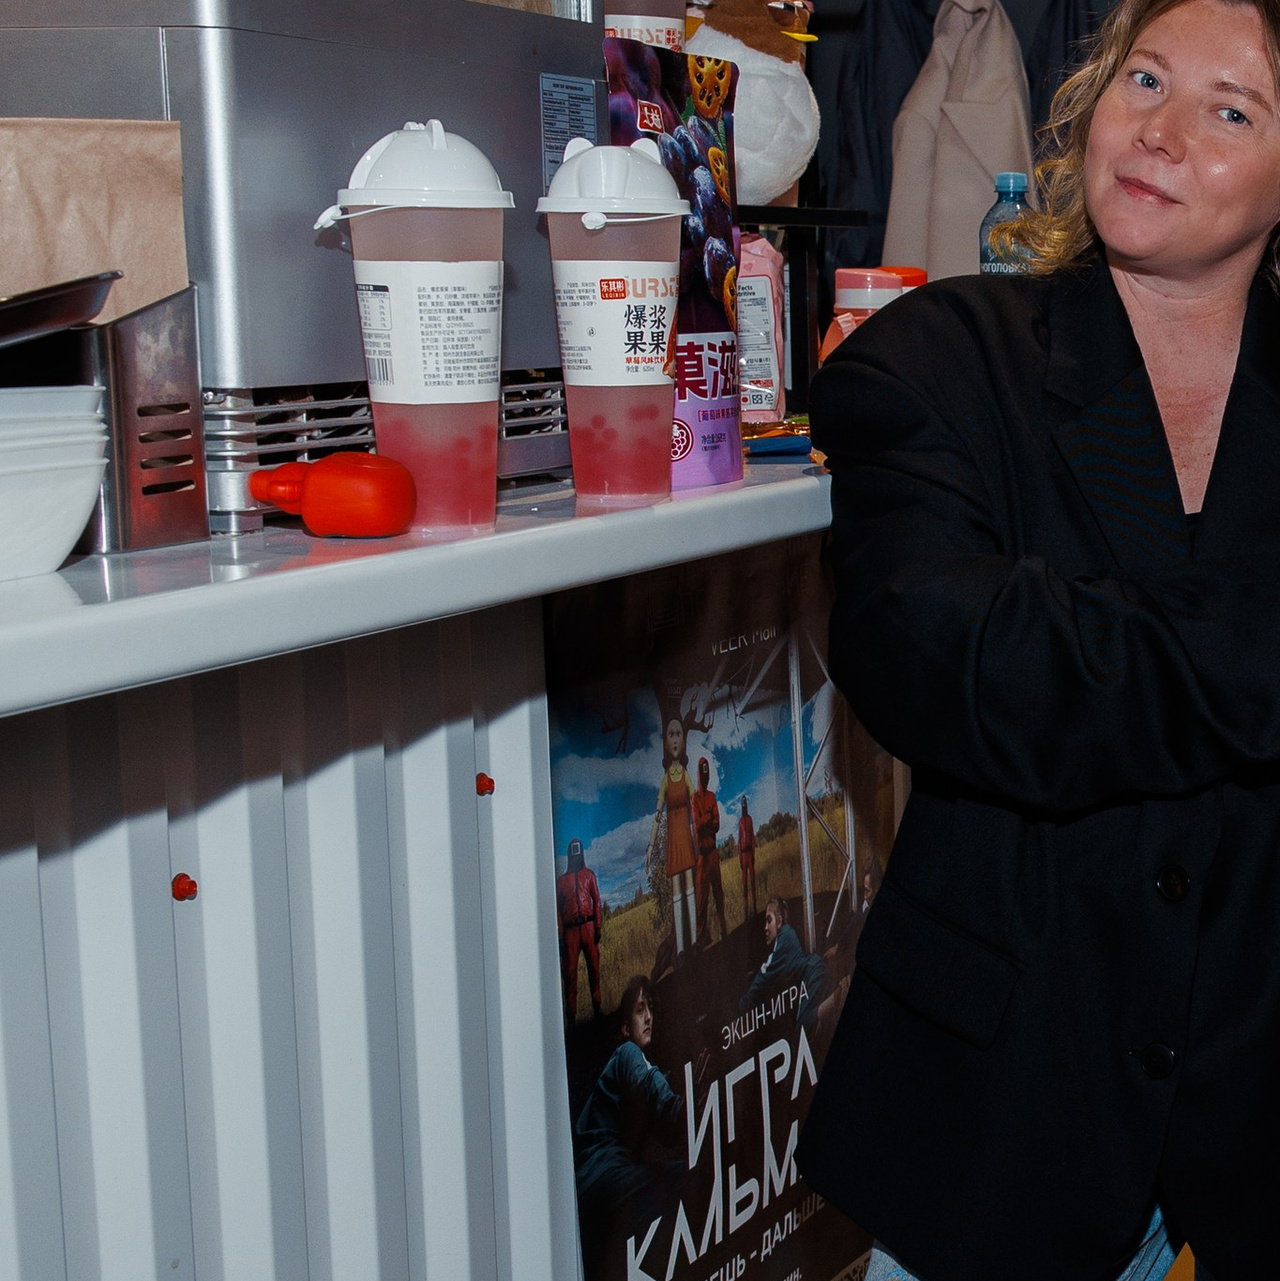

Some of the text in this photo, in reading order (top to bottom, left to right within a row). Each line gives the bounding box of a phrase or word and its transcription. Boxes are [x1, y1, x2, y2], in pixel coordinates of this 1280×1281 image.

[601, 280, 625, 293] 乐其彬
[623, 304, 667, 330] 爆浆
[623, 330, 667, 355] 果果
[720, 979, 810, 1051] ЭКШН-ИГРА
[684, 1024, 818, 1170] ИГРА
[760, 1193, 826, 1258] ДАЛЬШЕ
